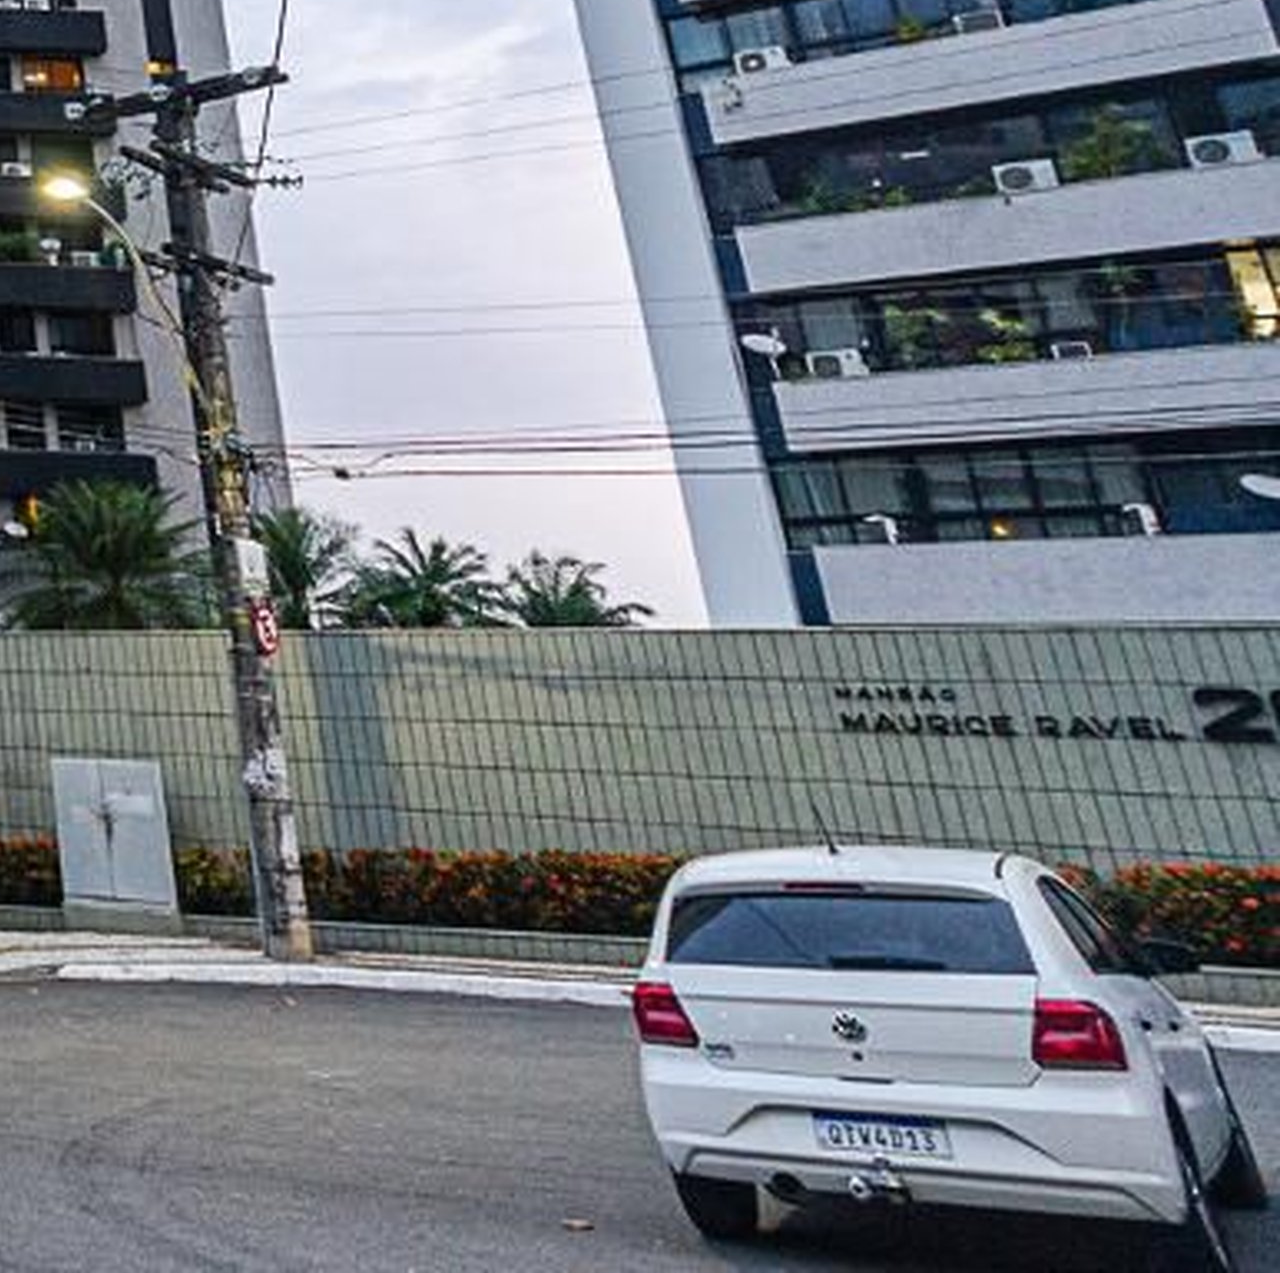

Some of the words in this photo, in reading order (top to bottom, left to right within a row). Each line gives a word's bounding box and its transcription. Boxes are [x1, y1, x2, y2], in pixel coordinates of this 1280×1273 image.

[840, 711, 1018, 737] MAURICE
[1034, 715, 1188, 742] RAVEL
[1193, 688, 1280, 744] 2
